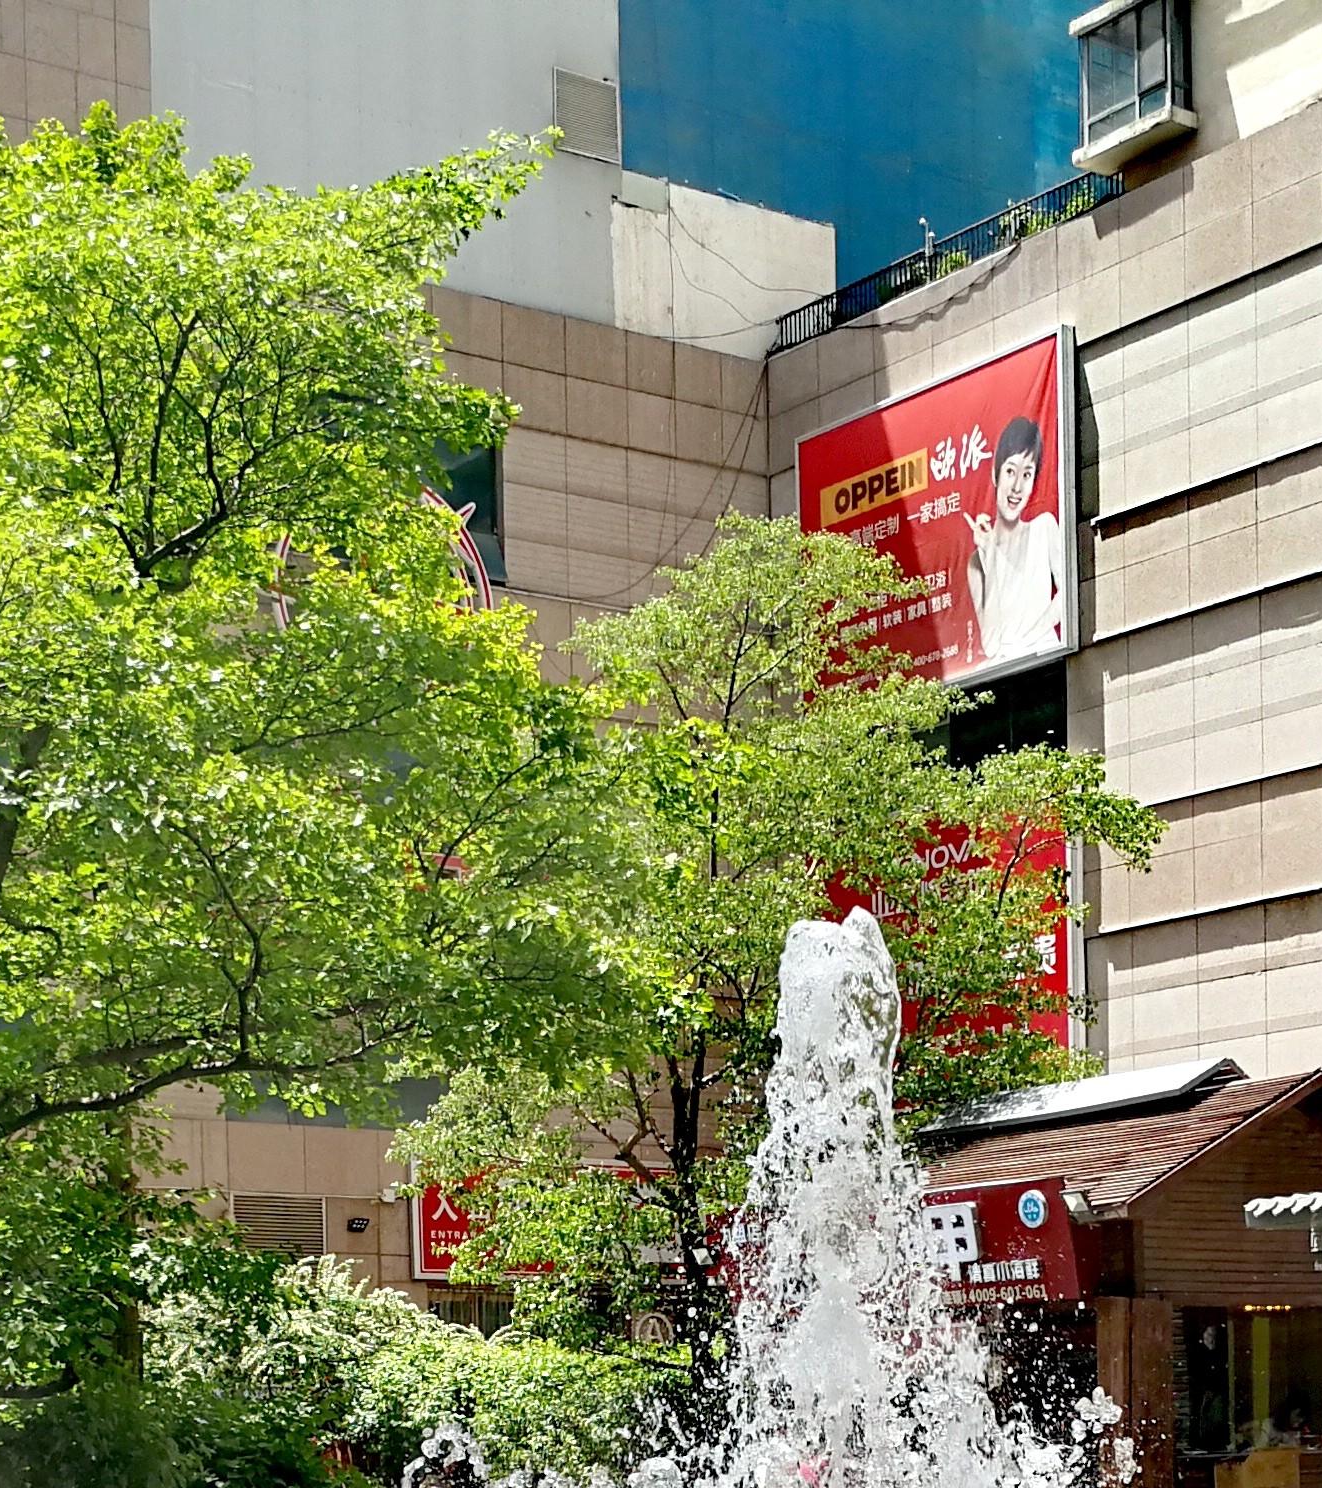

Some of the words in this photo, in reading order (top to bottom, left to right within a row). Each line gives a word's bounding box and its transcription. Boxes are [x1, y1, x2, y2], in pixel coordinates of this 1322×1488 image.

[834, 456, 924, 516] OPPEIN
[907, 492, 962, 524] 一家搞定
